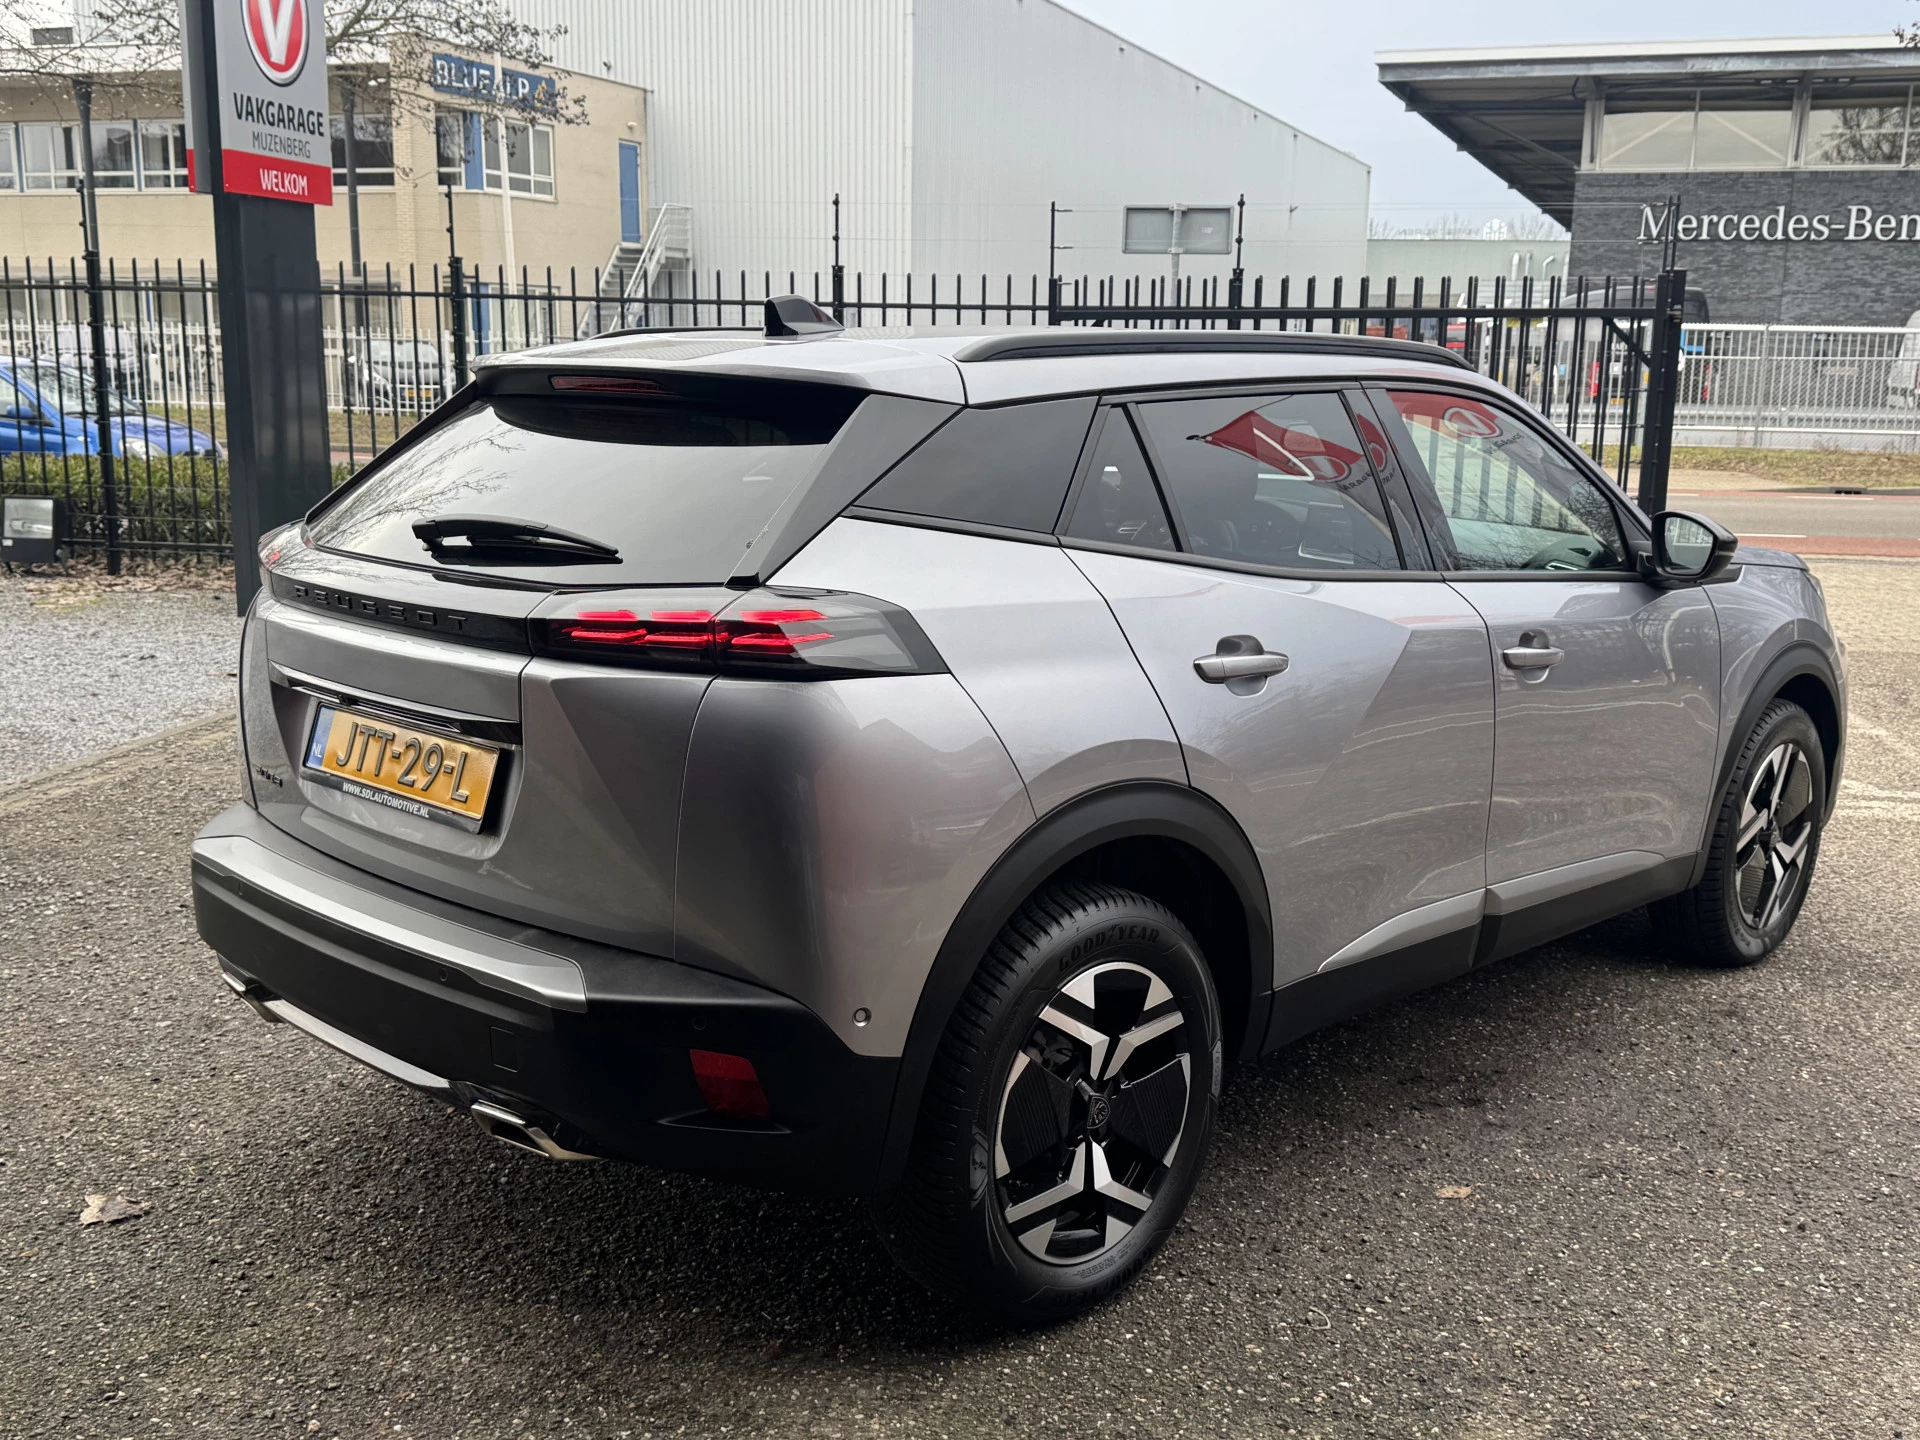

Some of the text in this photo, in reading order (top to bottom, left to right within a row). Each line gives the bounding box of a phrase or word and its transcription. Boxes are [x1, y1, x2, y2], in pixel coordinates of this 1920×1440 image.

[435, 59, 530, 100] BLUELP
[233, 92, 325, 137] VAKGARAGE
[252, 130, 311, 159] MUZENBERG
[259, 168, 308, 196] WELKOM
[294, 584, 469, 632] PEUGEOT
[311, 742, 323, 758] NL
[336, 721, 470, 804] JTT-29-L
[342, 781, 430, 818] WWW.SDLAUTOMOTIVE.NL
[1060, 923, 1160, 971] GOODYEAR
